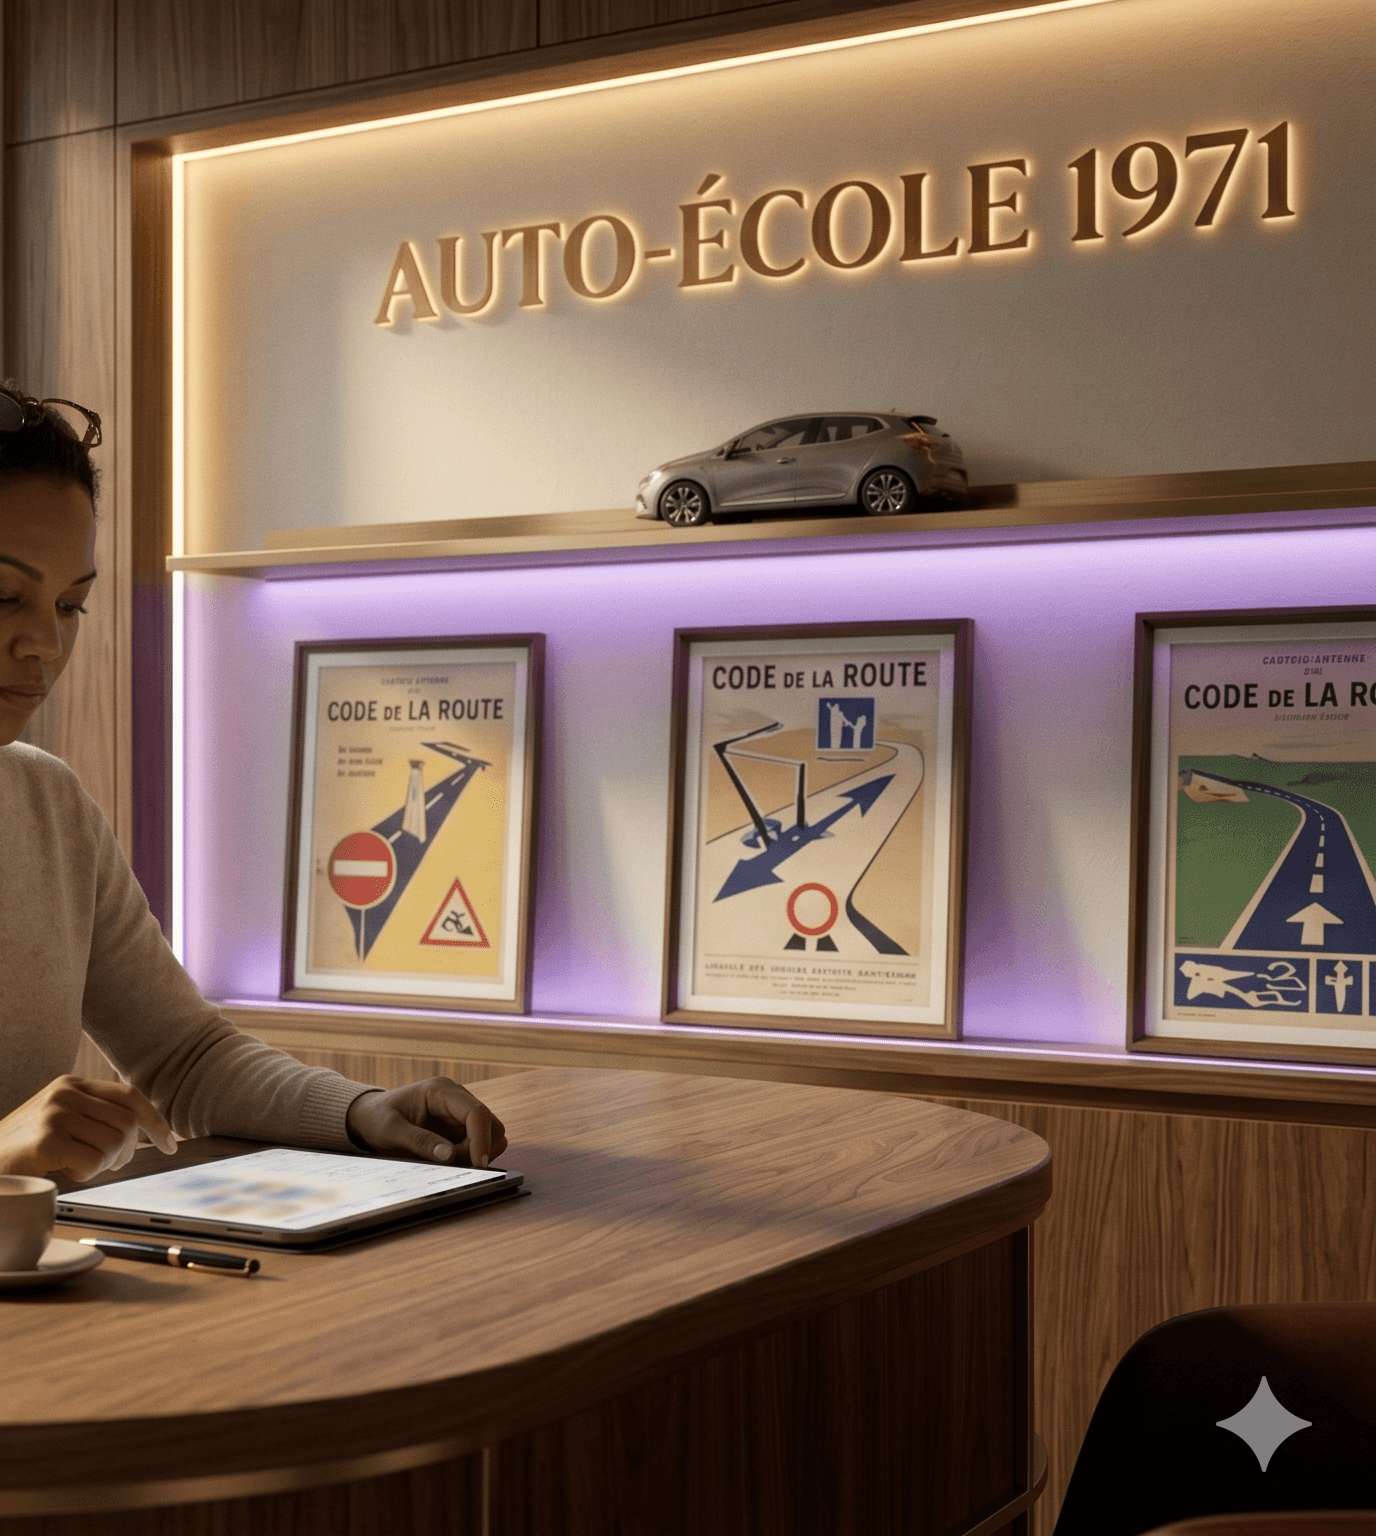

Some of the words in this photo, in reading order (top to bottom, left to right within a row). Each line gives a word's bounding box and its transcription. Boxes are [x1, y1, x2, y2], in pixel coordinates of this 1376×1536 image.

[373, 158, 1029, 325] AUTO-ÉCOLE
[1067, 121, 1296, 242] 1971
[712, 665, 776, 690] CODE
[783, 672, 805, 688] DE
[812, 670, 834, 688] LA
[843, 662, 927, 688] ROUTE
[1184, 683, 1258, 709] CODE
[1268, 689, 1295, 708] DE
[1305, 682, 1339, 707] LA
[327, 700, 378, 722] CODE
[383, 705, 402, 721] DE
[408, 700, 431, 721] LA
[438, 698, 504, 721] ROUTE
